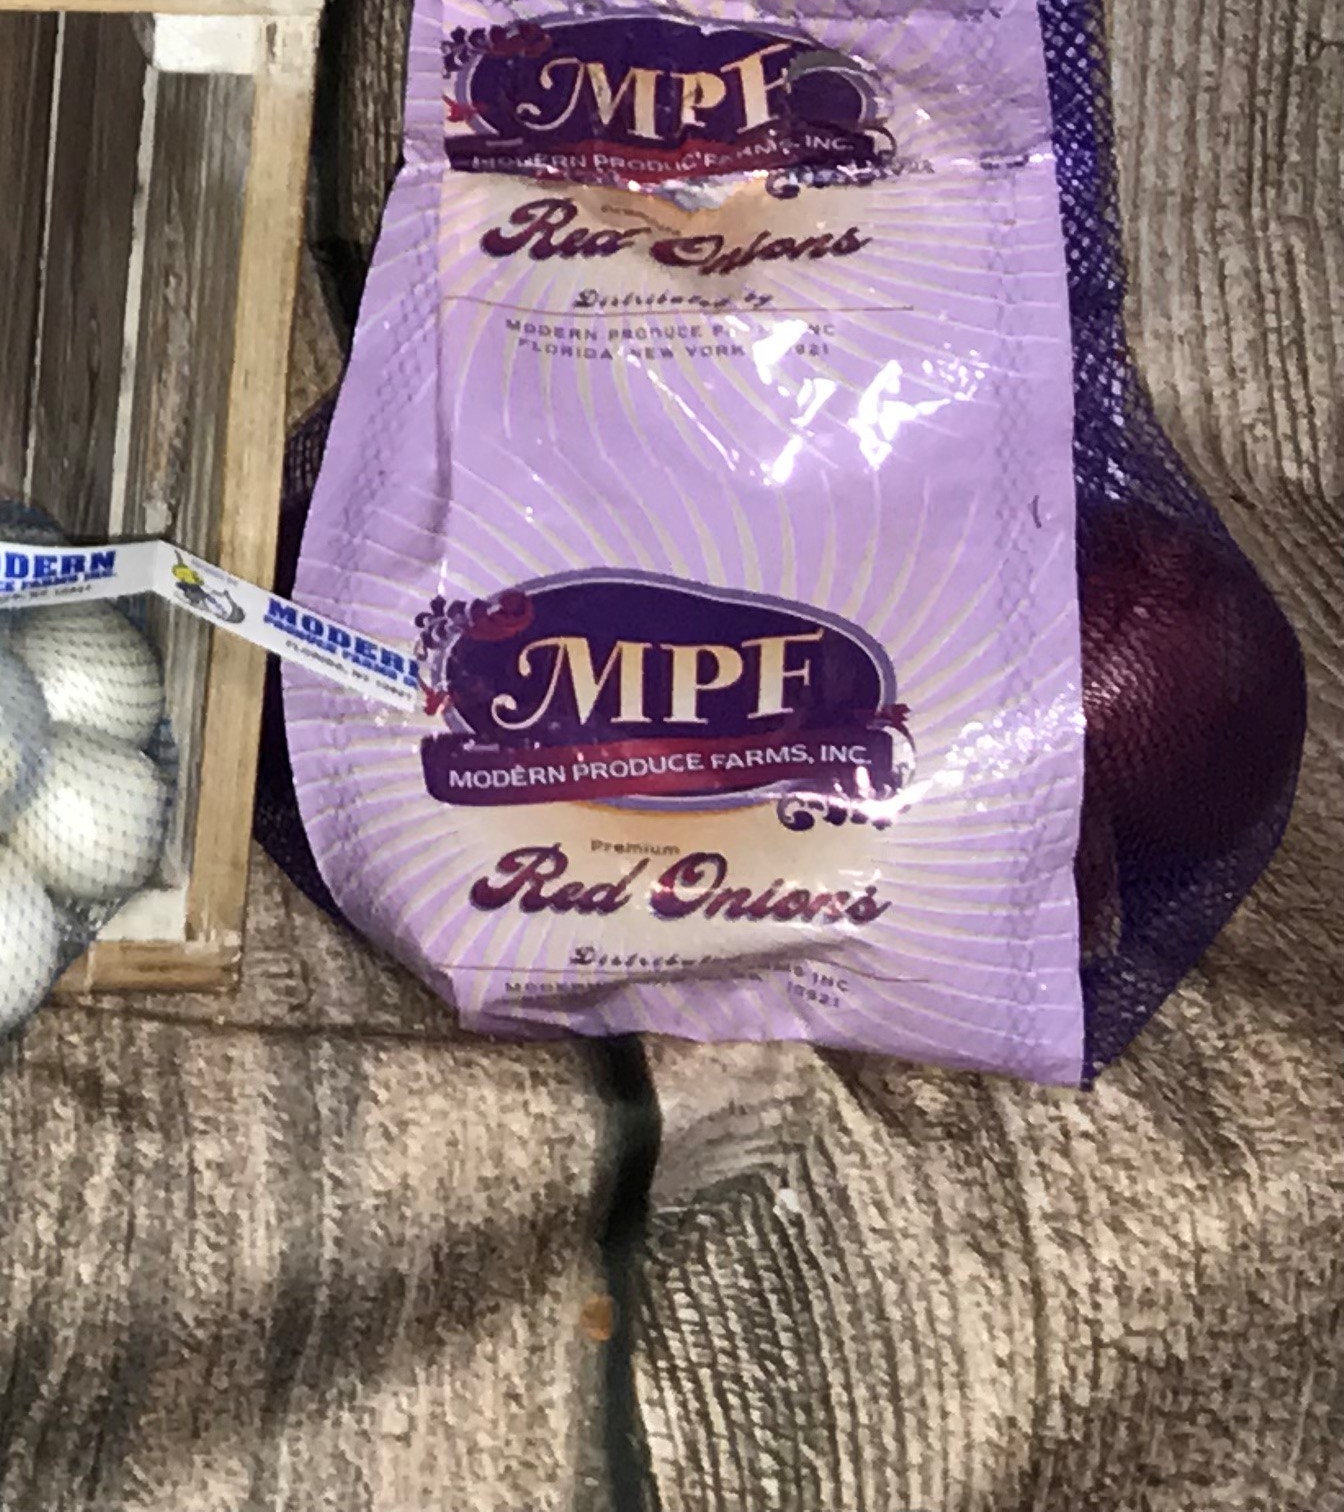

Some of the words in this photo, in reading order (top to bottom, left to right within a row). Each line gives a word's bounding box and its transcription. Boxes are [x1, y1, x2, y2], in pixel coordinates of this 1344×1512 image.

[516, 42, 794, 141] MPF
[491, 627, 825, 732] MPF
[449, 767, 566, 790] MODERN
[573, 753, 704, 783] PRODUCE
[711, 745, 814, 771] FARMS,
[820, 744, 873, 766] INC.
[469, 842, 649, 916] Red
[647, 852, 894, 926] Onions
[590, 838, 681, 858] Premium
